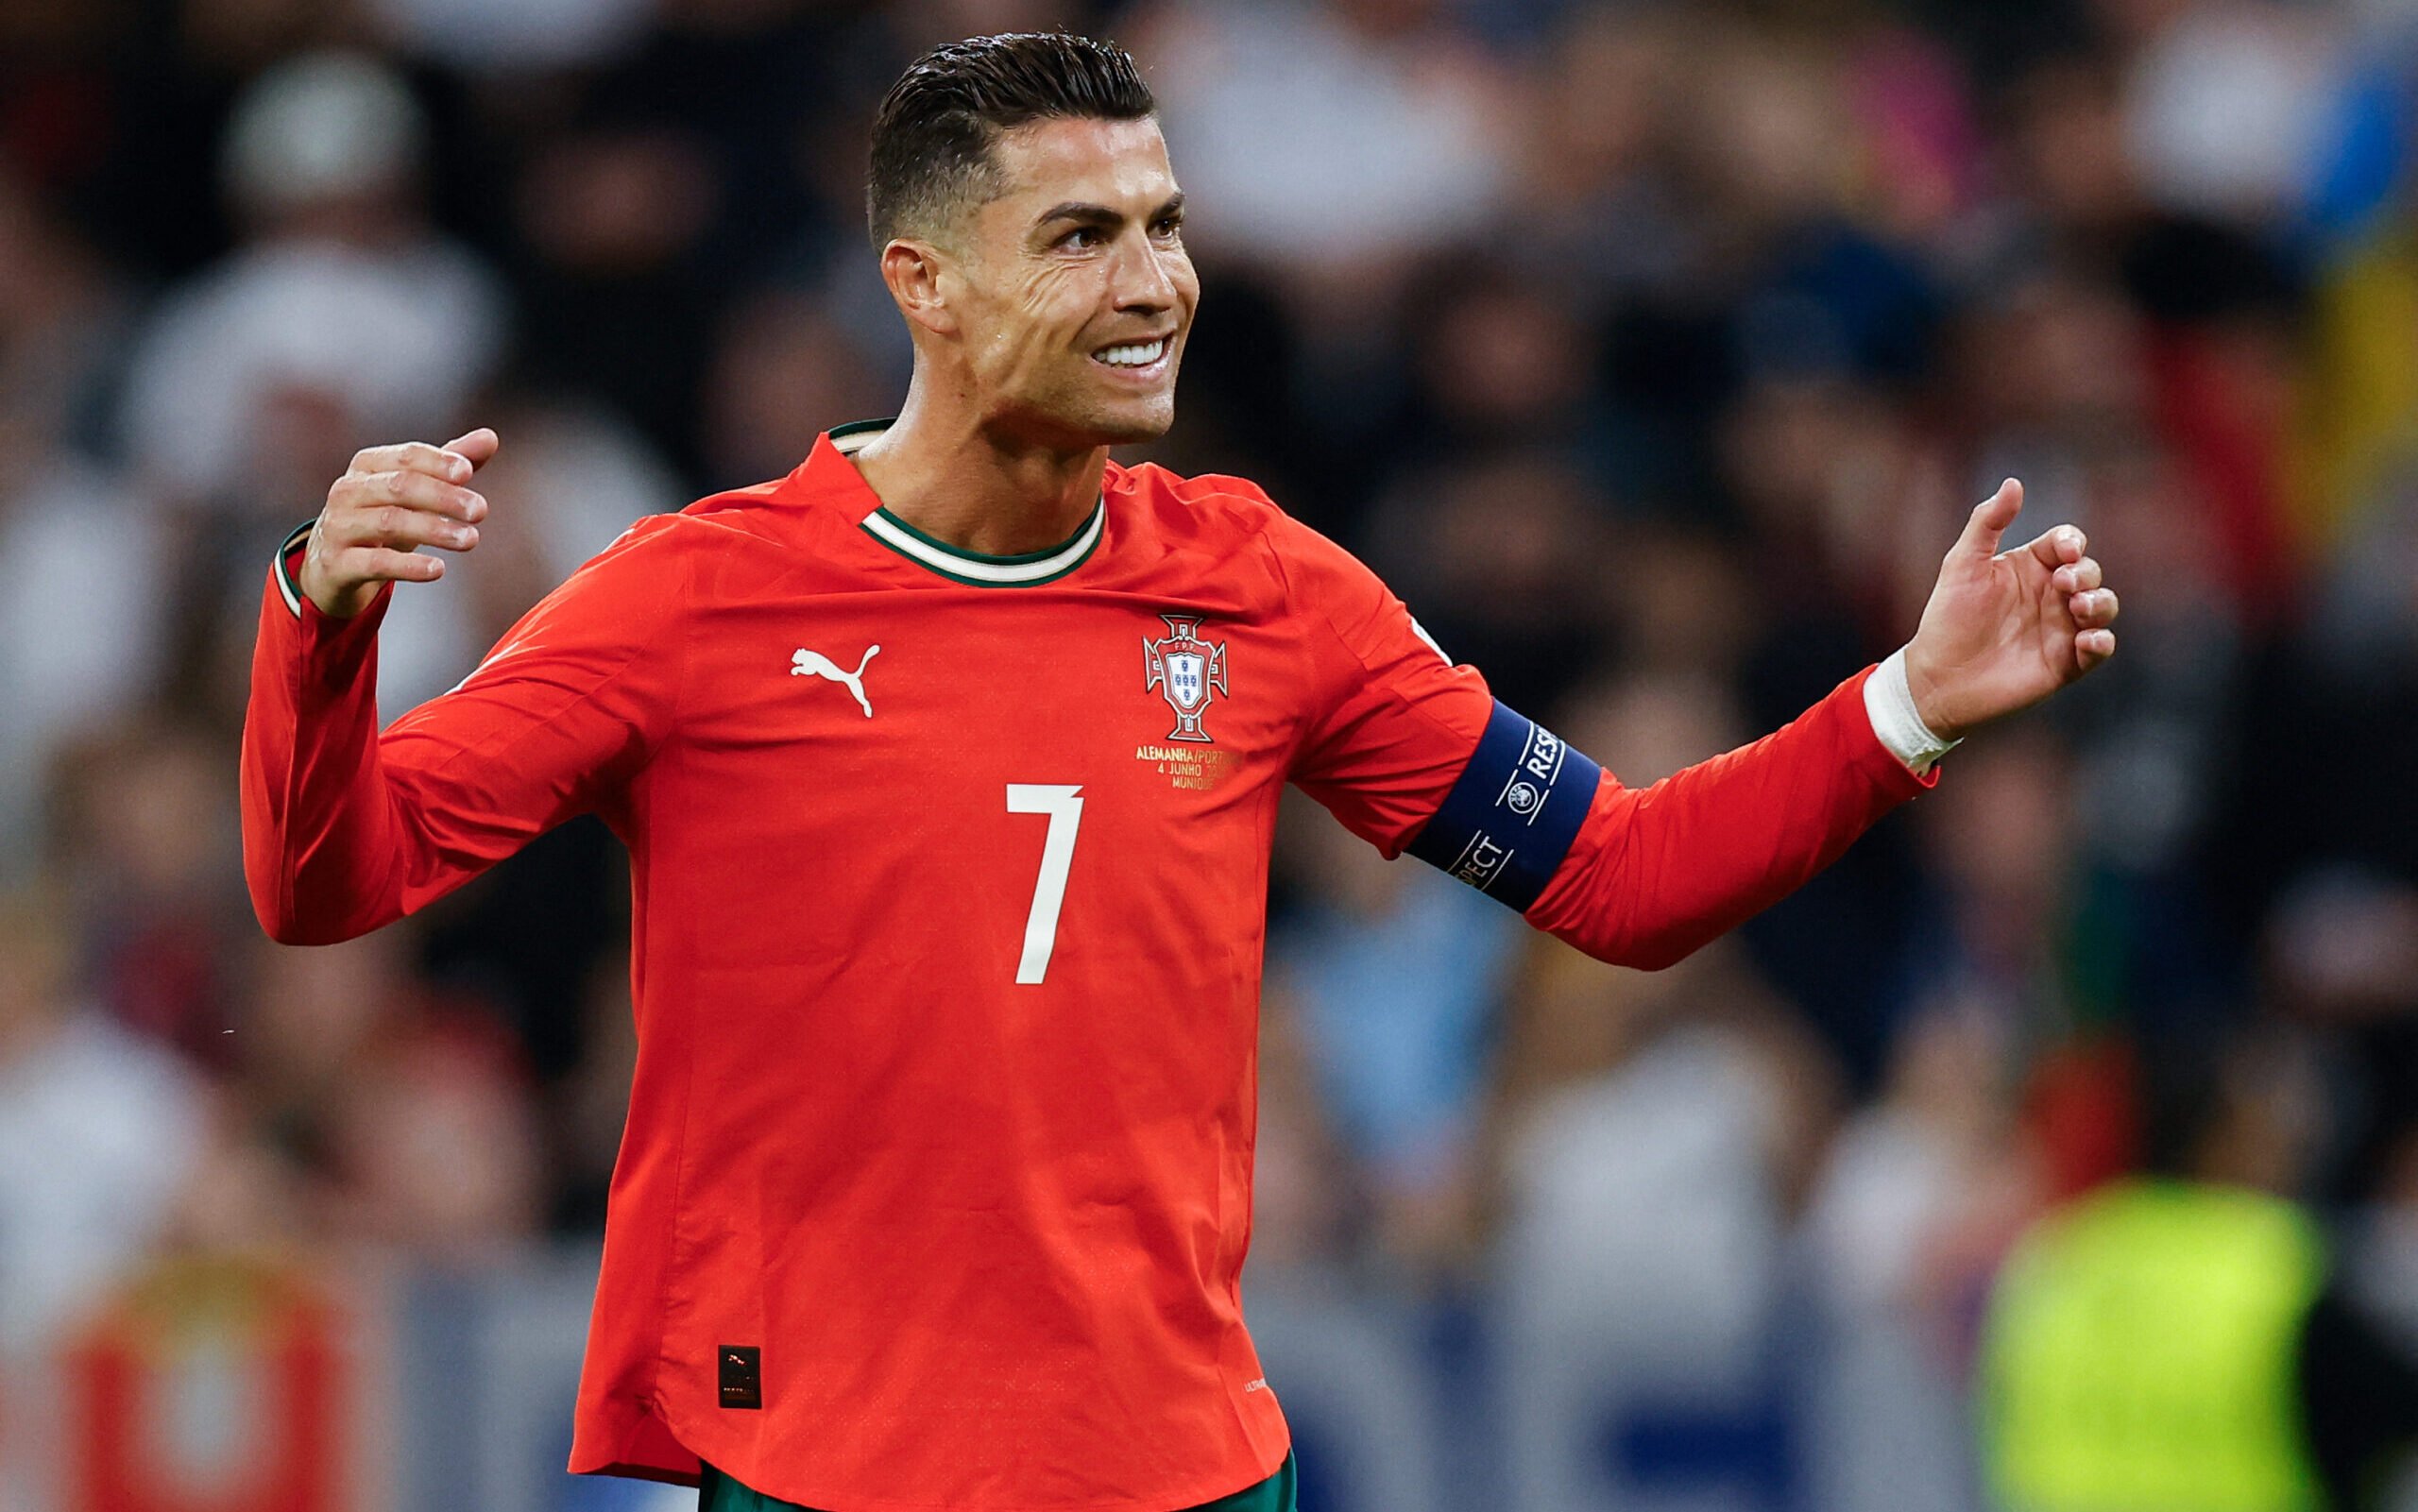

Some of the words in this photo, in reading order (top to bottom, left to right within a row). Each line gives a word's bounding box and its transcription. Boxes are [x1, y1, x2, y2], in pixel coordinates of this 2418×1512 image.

[1158, 763, 1164, 773] 4
[1169, 763, 1201, 776] JUNHO
[1006, 784, 1084, 984] 7
